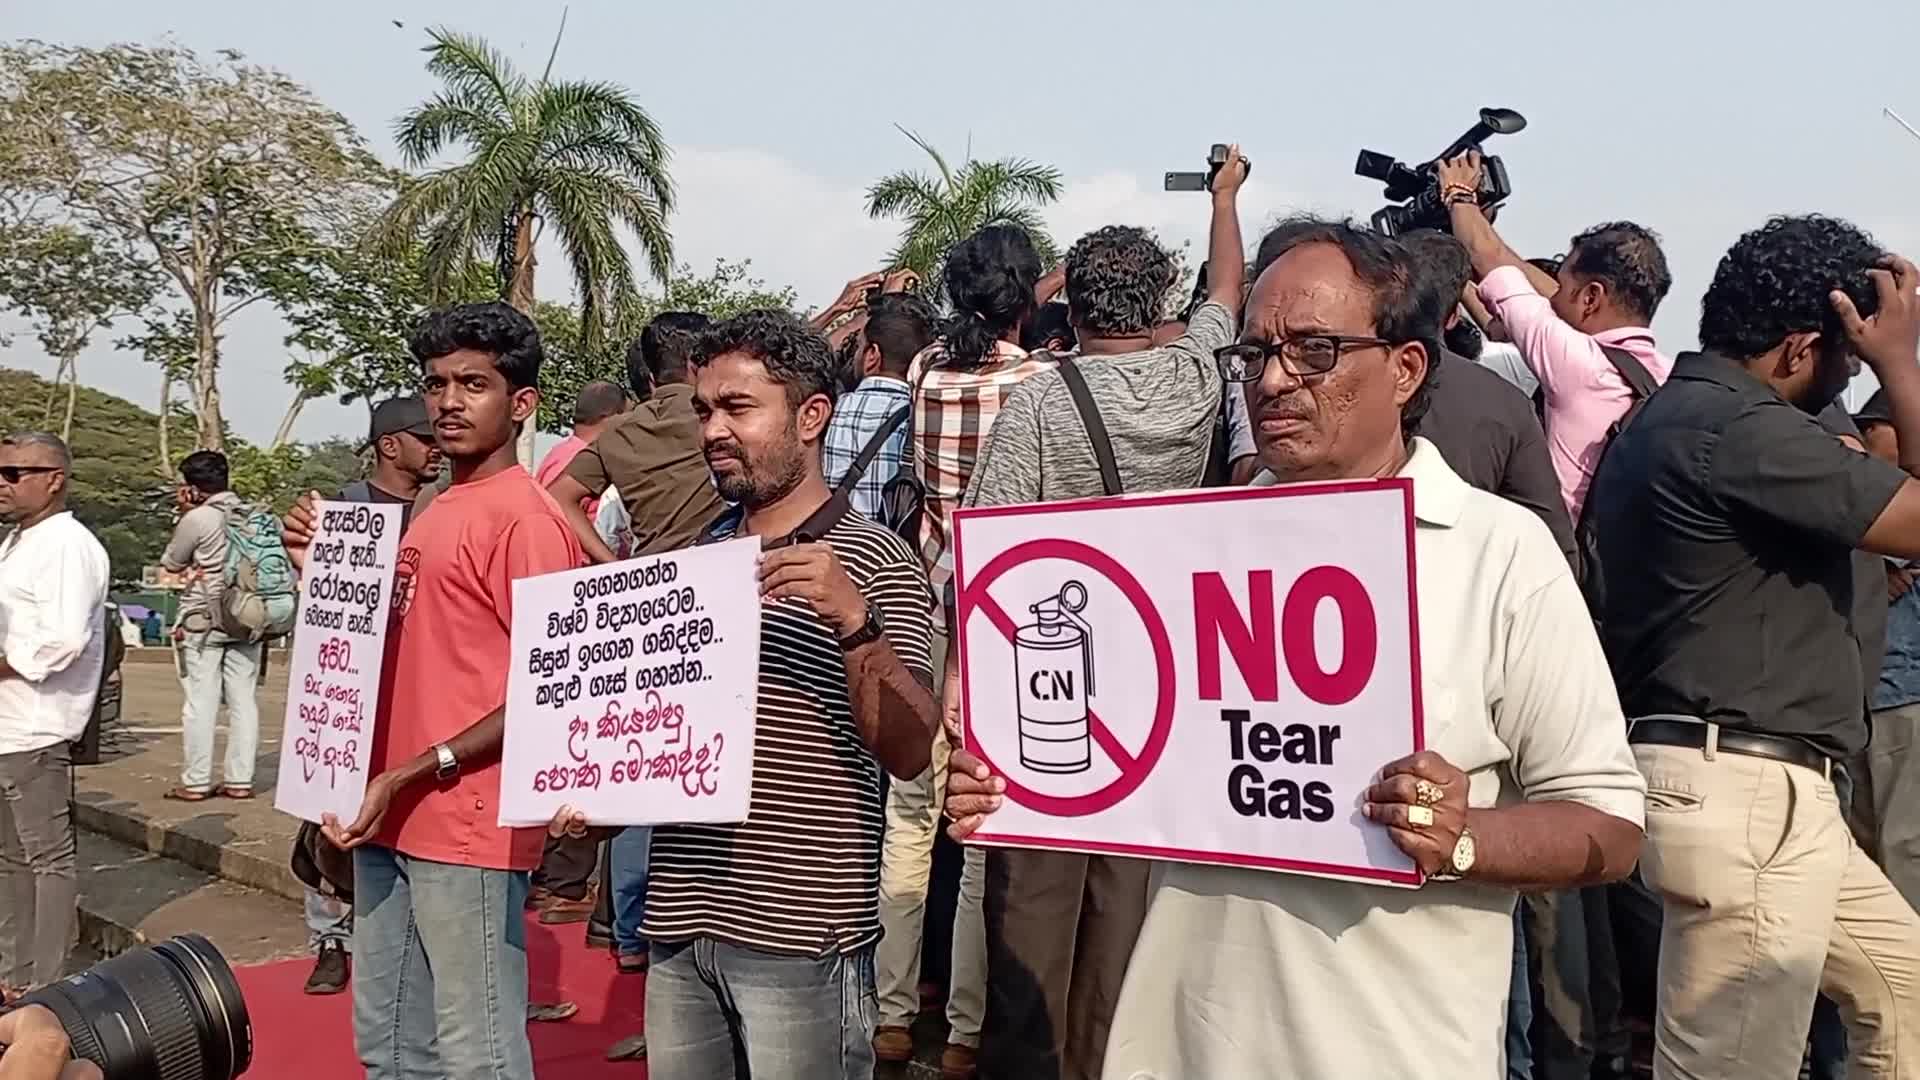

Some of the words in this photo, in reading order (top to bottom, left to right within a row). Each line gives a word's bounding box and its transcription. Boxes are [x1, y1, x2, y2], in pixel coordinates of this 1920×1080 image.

[309, 573, 381, 610] රෝහලේ
[574, 558, 678, 607] ඉගෙනගත්ත
[547, 608, 588, 638] විශ්ව
[1192, 565, 1377, 706] NO
[529, 643, 570, 678] සිසුන්
[578, 637, 634, 671] ඉගෙන
[590, 666, 627, 698] ගෑස්
[636, 657, 712, 691] ගහන්න..
[1029, 670, 1074, 701] CN
[1221, 709, 1341, 765] Tear
[1228, 765, 1334, 822] Gas
